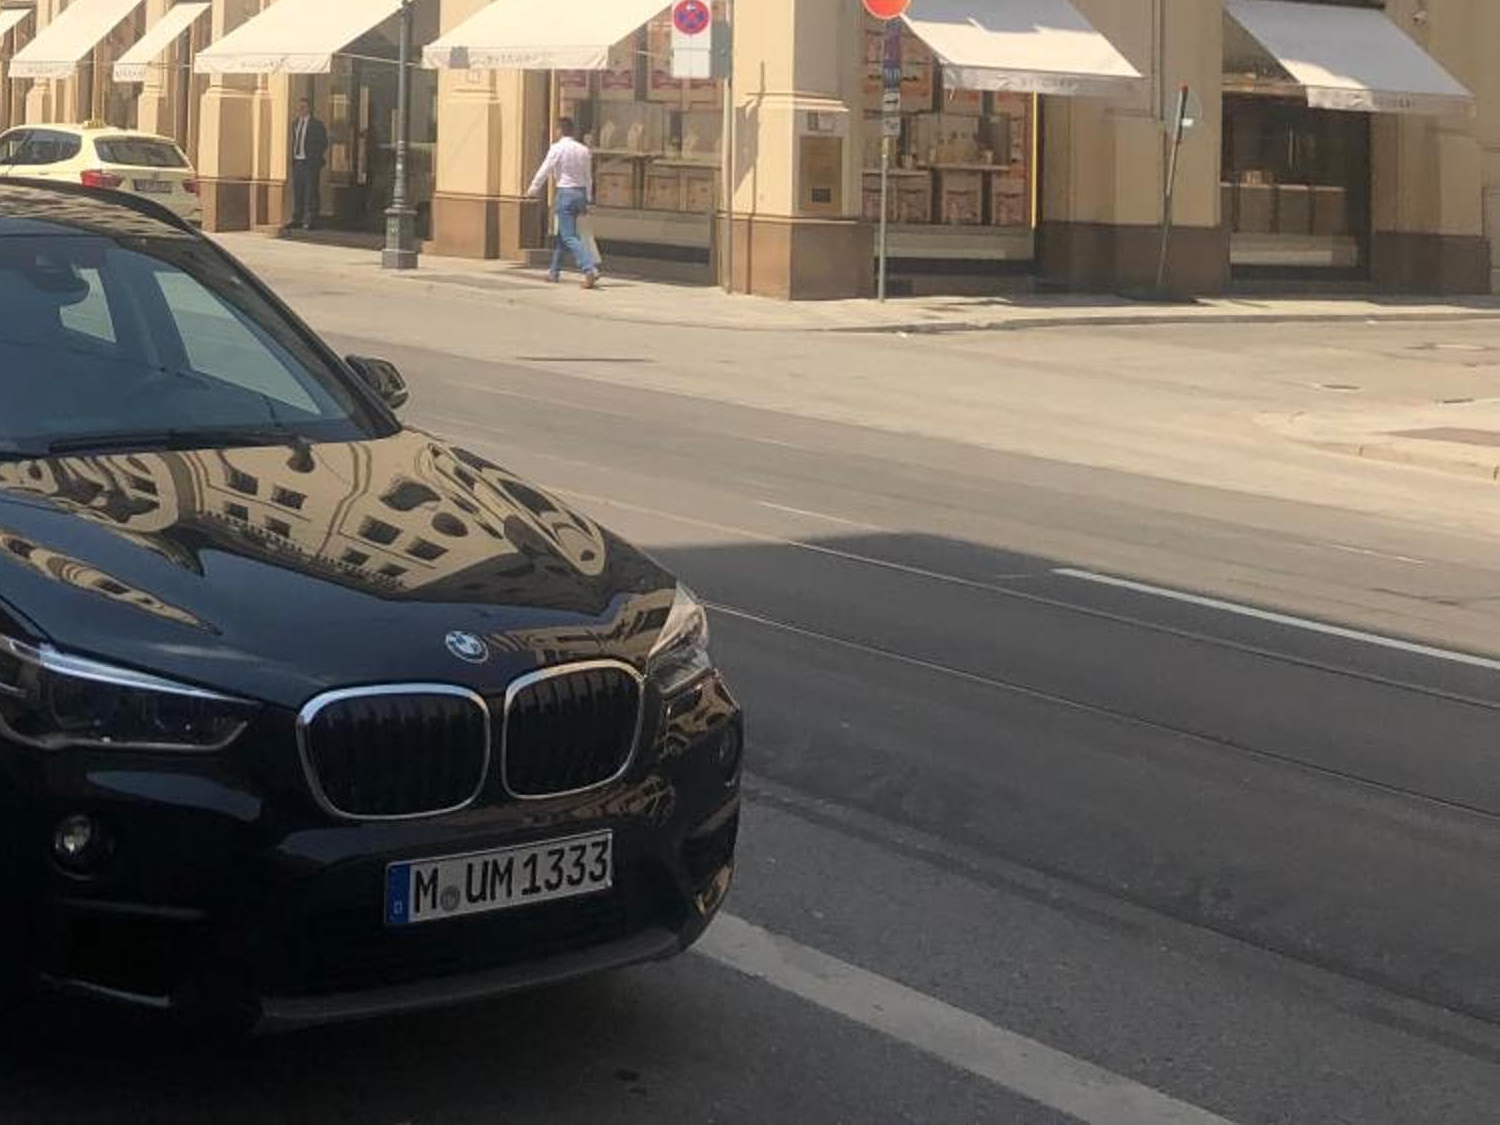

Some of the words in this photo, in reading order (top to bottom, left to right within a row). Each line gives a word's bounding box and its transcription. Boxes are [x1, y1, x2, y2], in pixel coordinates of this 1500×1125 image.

[415, 867, 439, 914] M
[466, 857, 514, 904] UM
[521, 840, 609, 896] 1333
